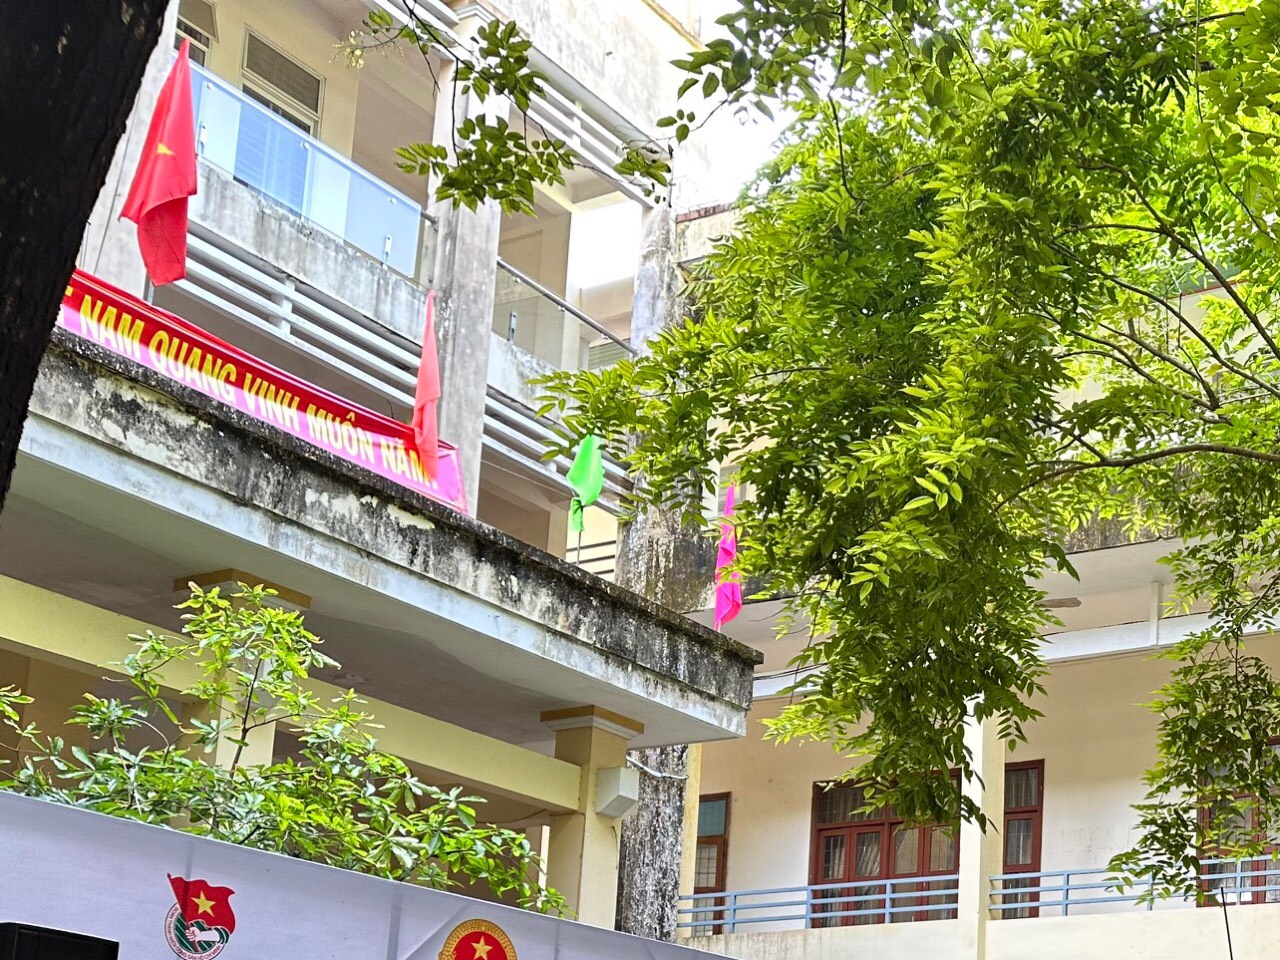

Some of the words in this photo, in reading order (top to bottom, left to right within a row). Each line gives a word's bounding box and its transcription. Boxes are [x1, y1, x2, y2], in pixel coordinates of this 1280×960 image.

[79, 294, 145, 362] NAM
[148, 330, 238, 400] QUANG
[243, 373, 300, 431] VINH
[306, 403, 375, 464] MUÔN
[380, 435, 438, 489] NĂM
